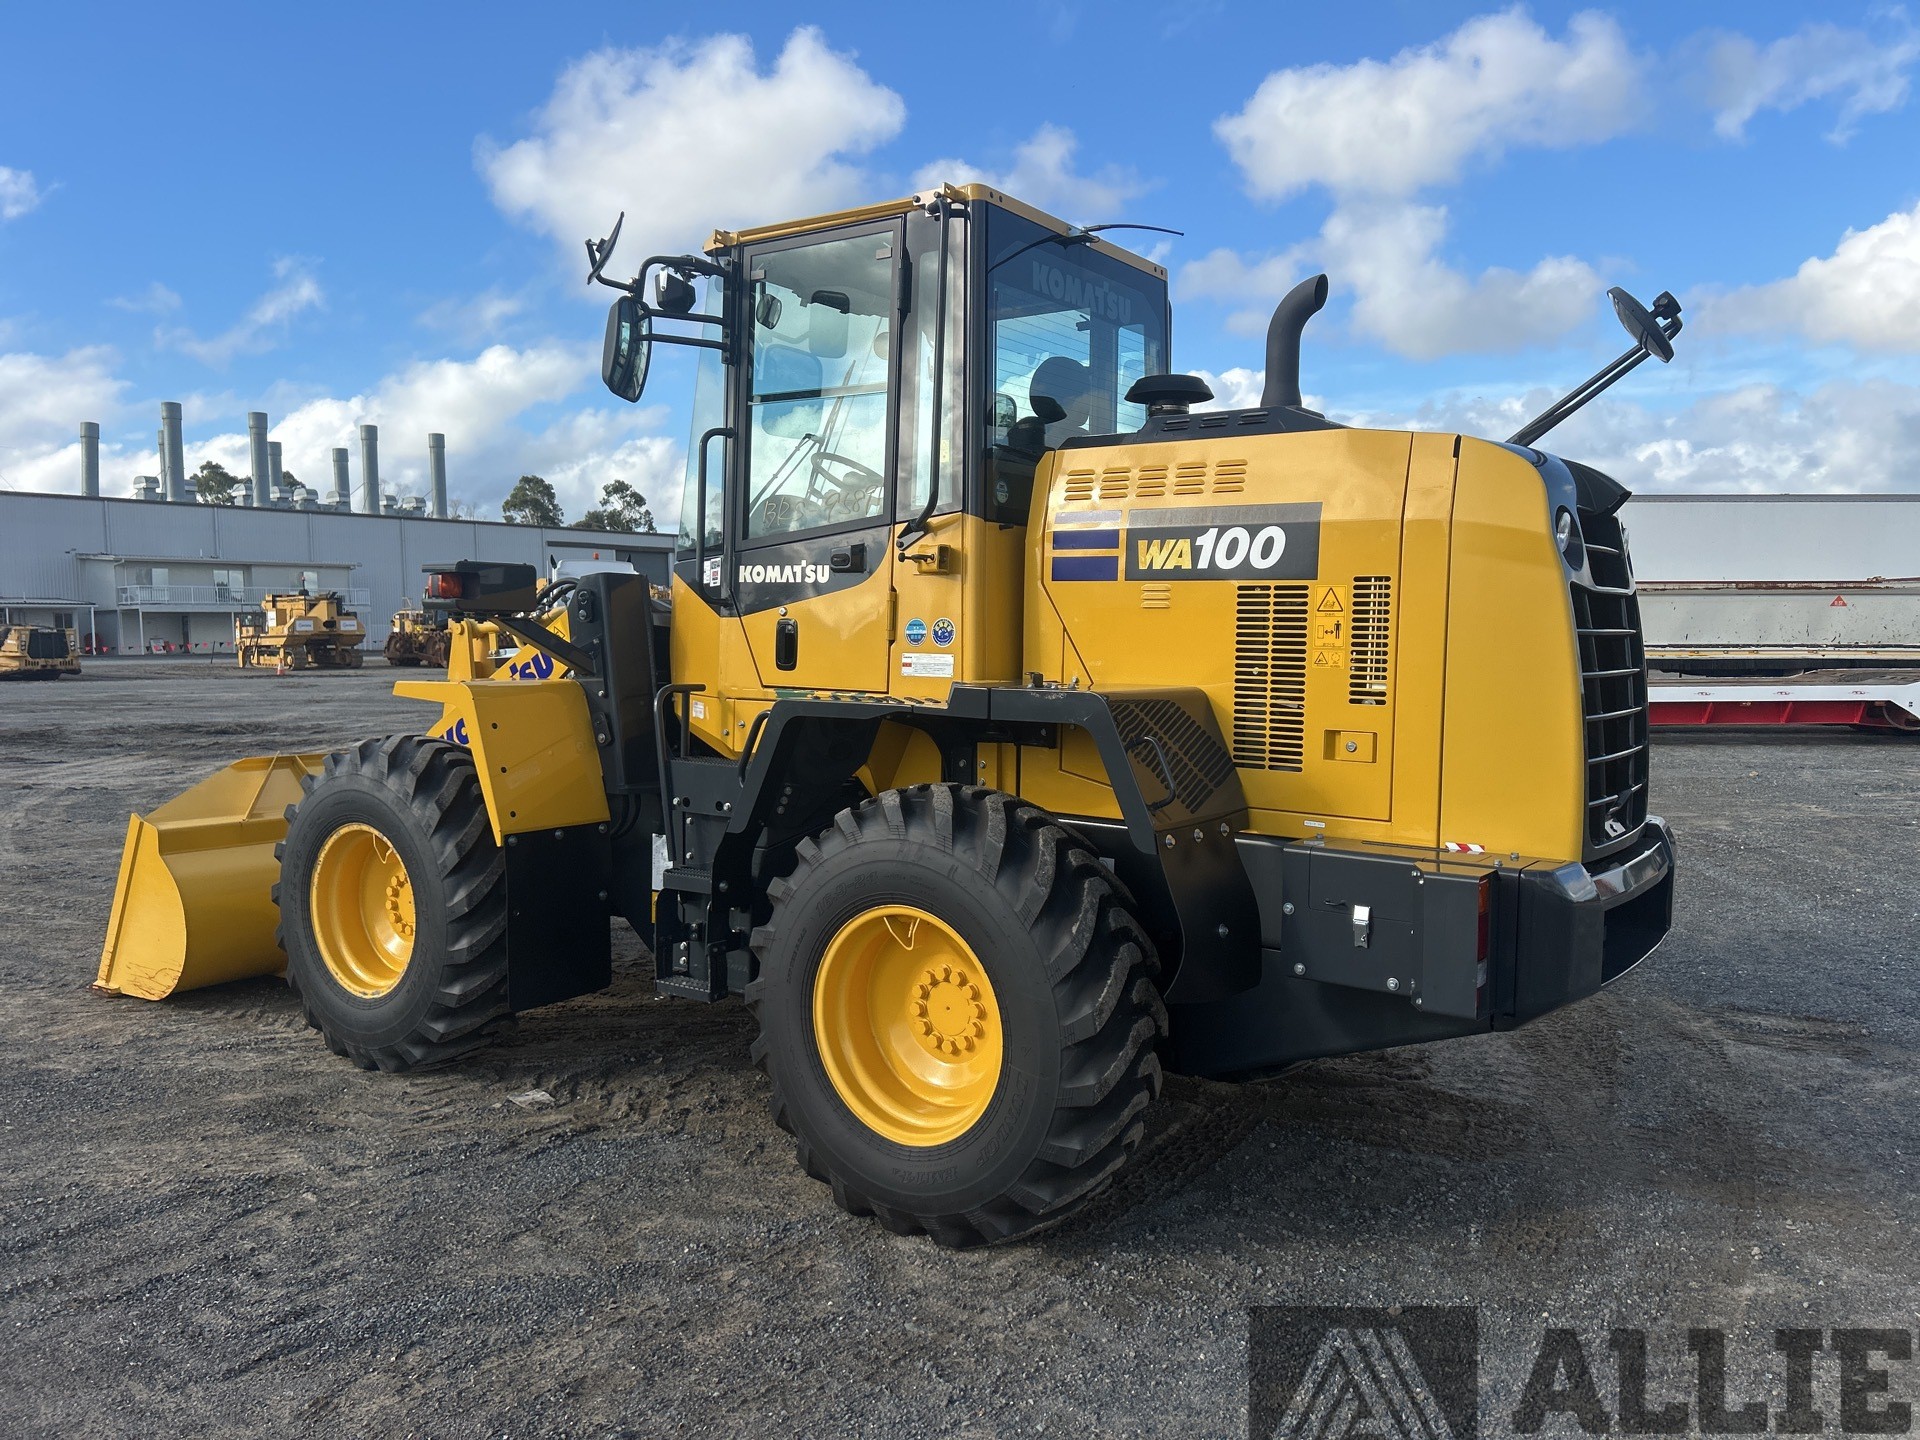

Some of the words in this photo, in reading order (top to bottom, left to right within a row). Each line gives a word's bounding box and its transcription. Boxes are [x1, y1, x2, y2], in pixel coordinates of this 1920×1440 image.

[1032, 260, 1131, 323] KOMATSU
[1138, 525, 1287, 570] WA100
[739, 560, 830, 583] KOMATSU
